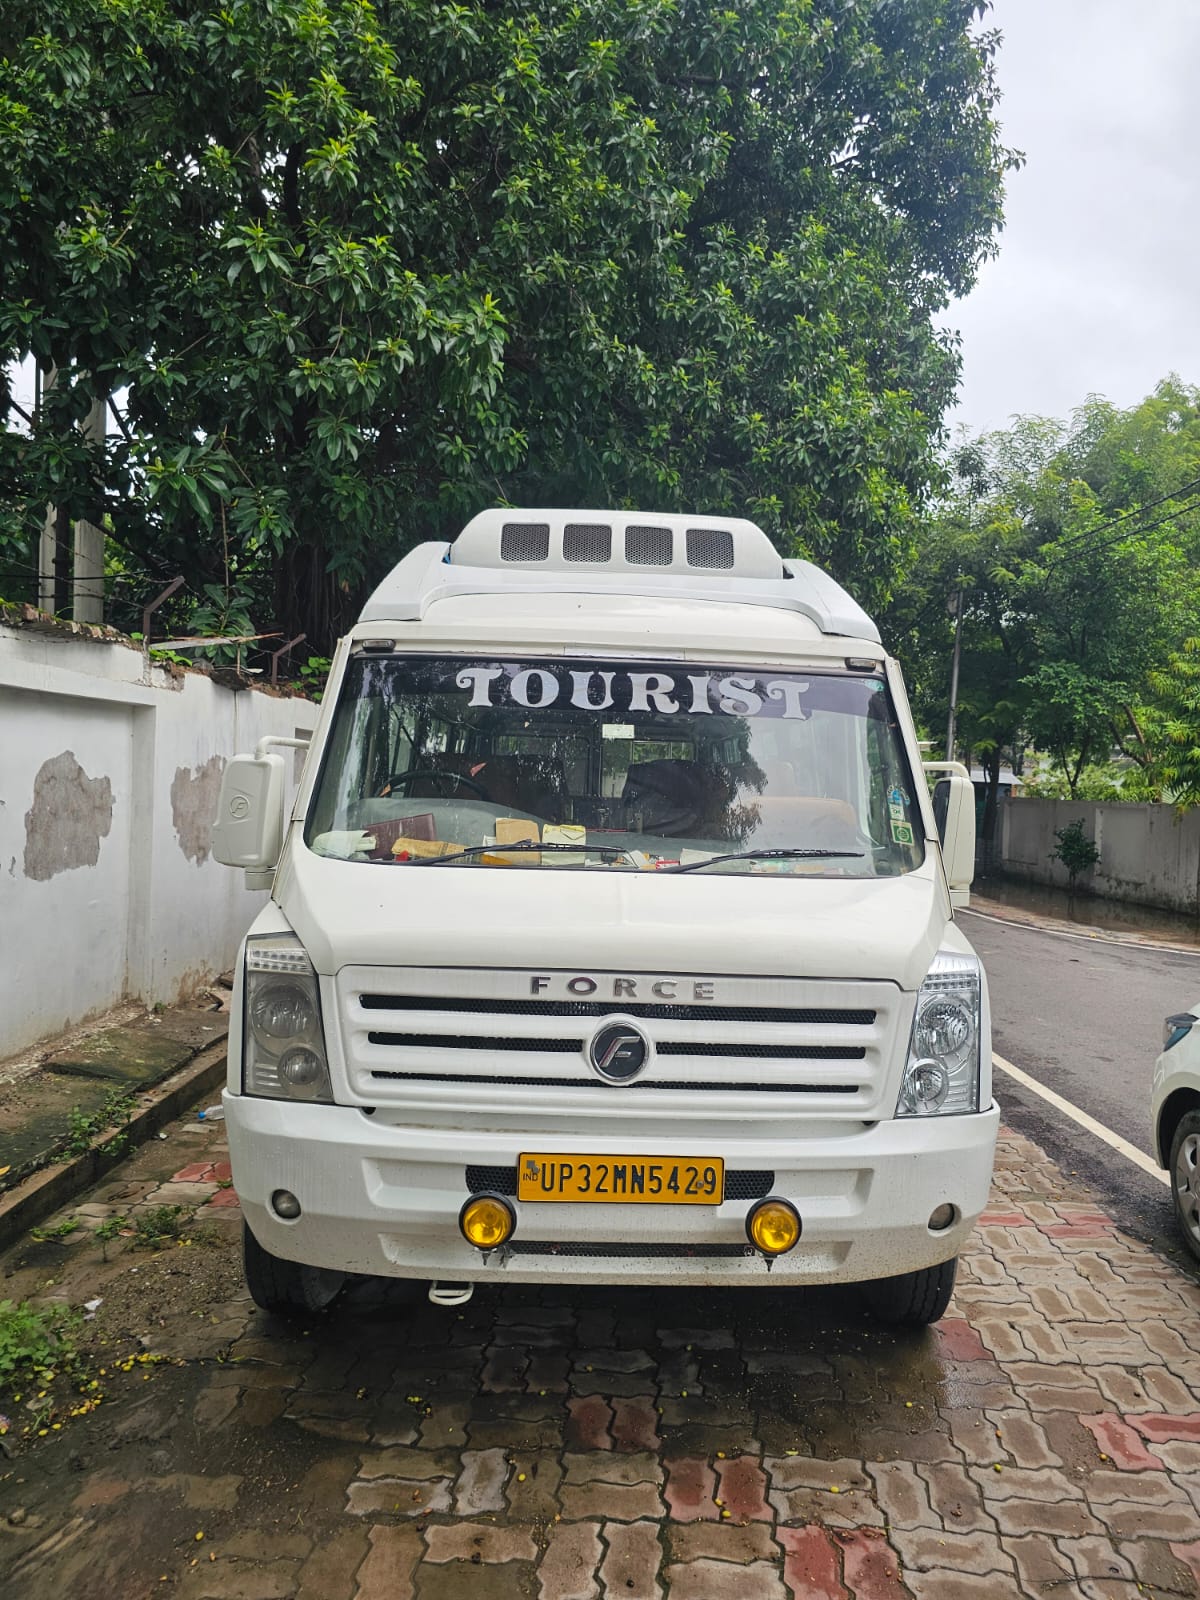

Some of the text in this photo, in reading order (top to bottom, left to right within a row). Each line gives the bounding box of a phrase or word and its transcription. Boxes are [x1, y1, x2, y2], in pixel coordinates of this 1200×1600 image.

[455, 667, 810, 721] TOURIST
[529, 976, 715, 1001] FORCE
[522, 1172, 539, 1182] IND
[541, 1162, 717, 1196] UP32MN5429
